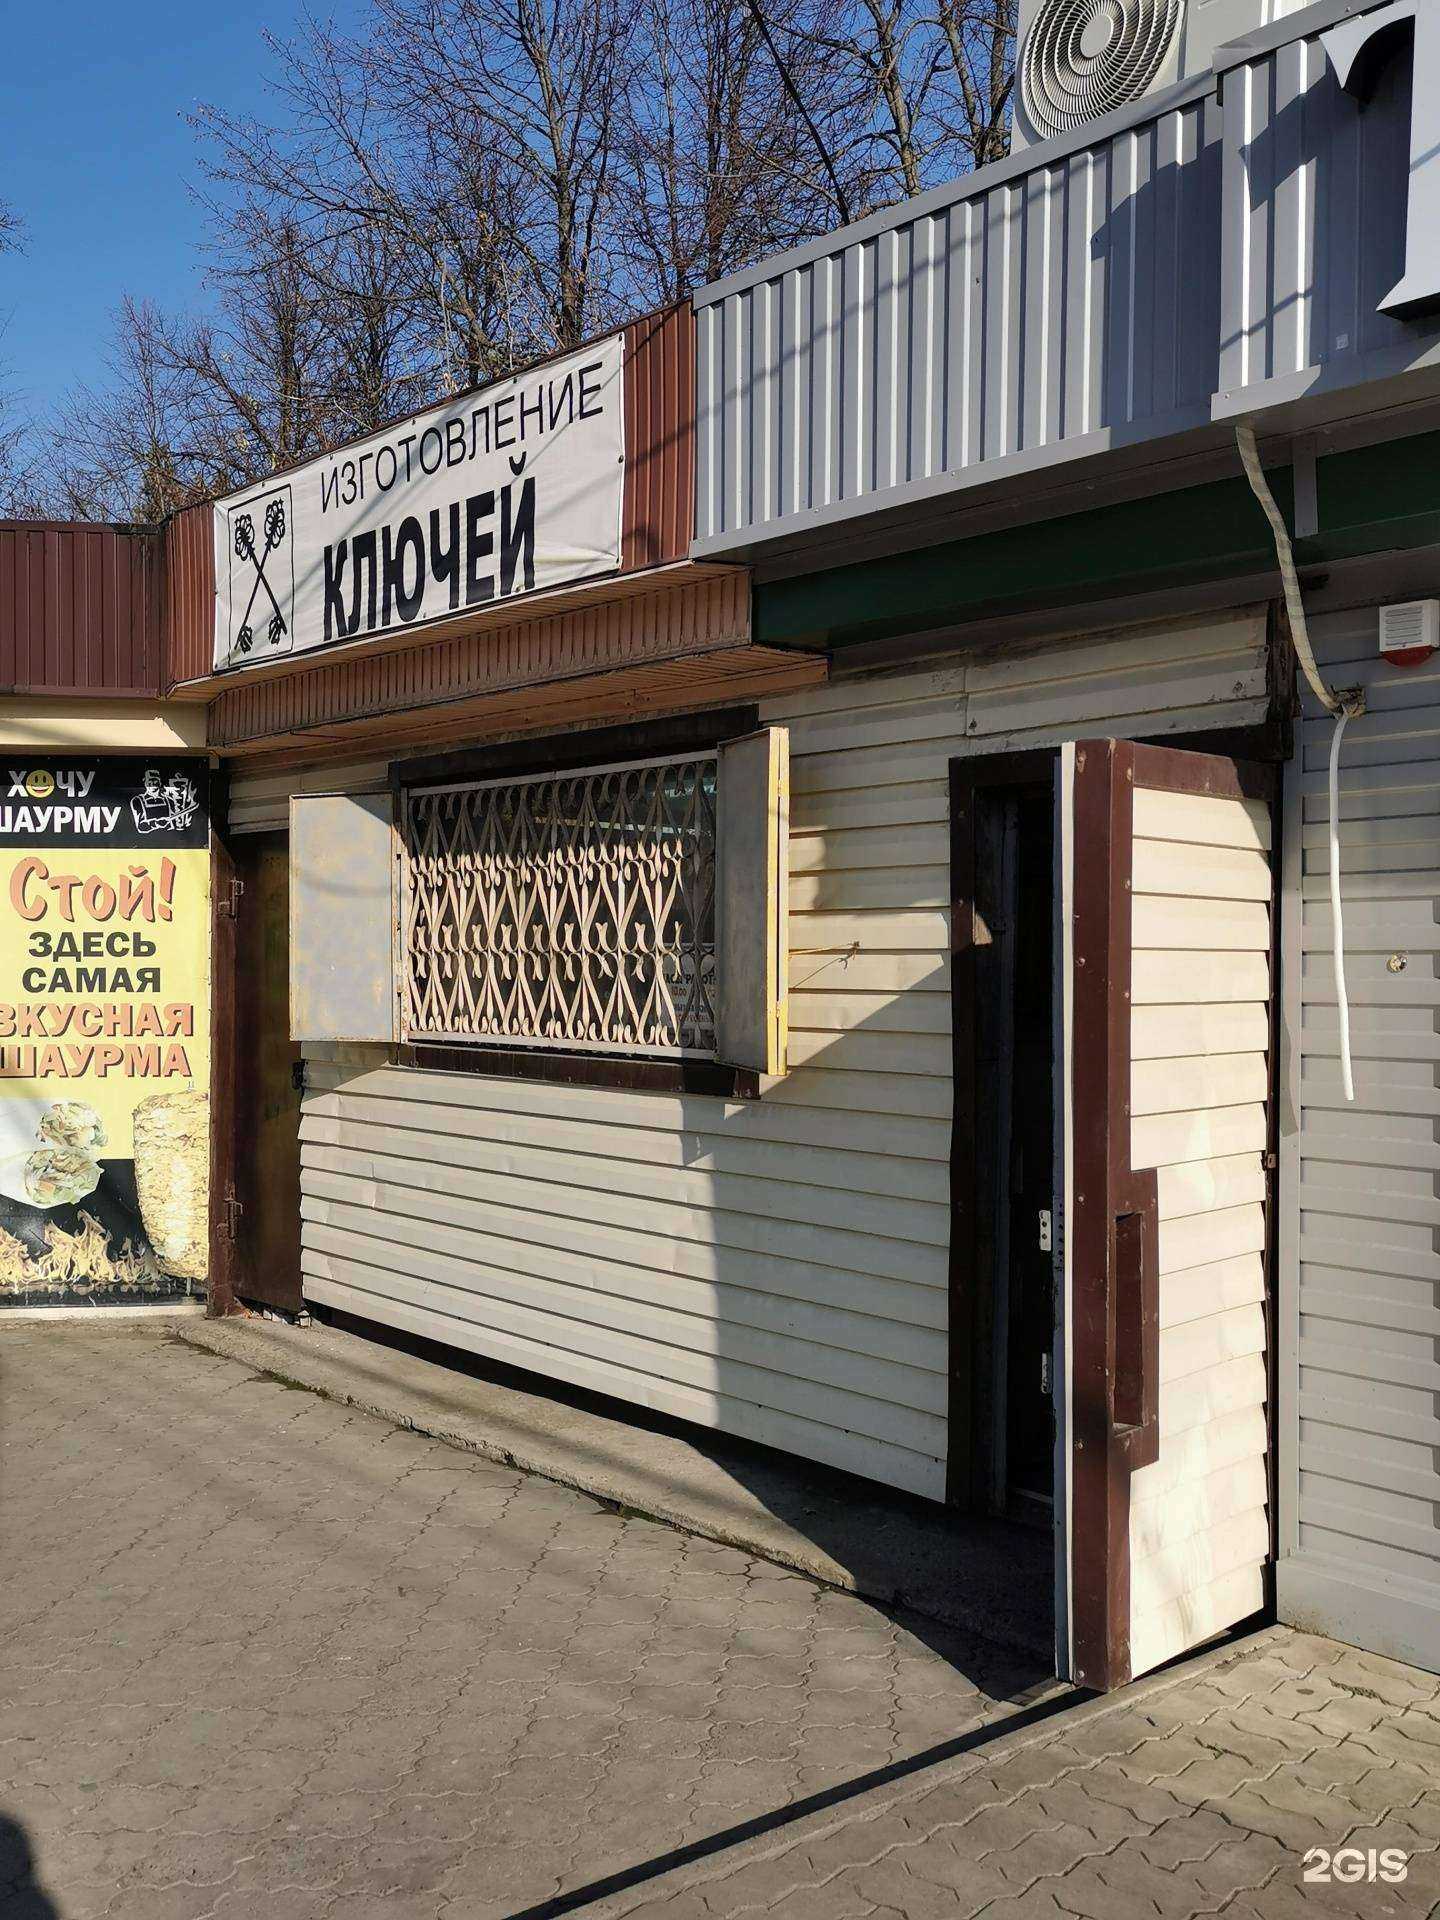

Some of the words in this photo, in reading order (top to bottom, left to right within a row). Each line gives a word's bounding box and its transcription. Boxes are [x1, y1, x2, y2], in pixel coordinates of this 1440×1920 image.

[321, 361, 603, 514] ИЗГОТОВЛЕНИЕ
[323, 451, 536, 642] КЛЮЧЕЙ
[28, 931, 157, 962] ЗДЕСЬ
[22, 967, 161, 993] САМАЯ
[0, 1043, 192, 1078] ШАУРМА
